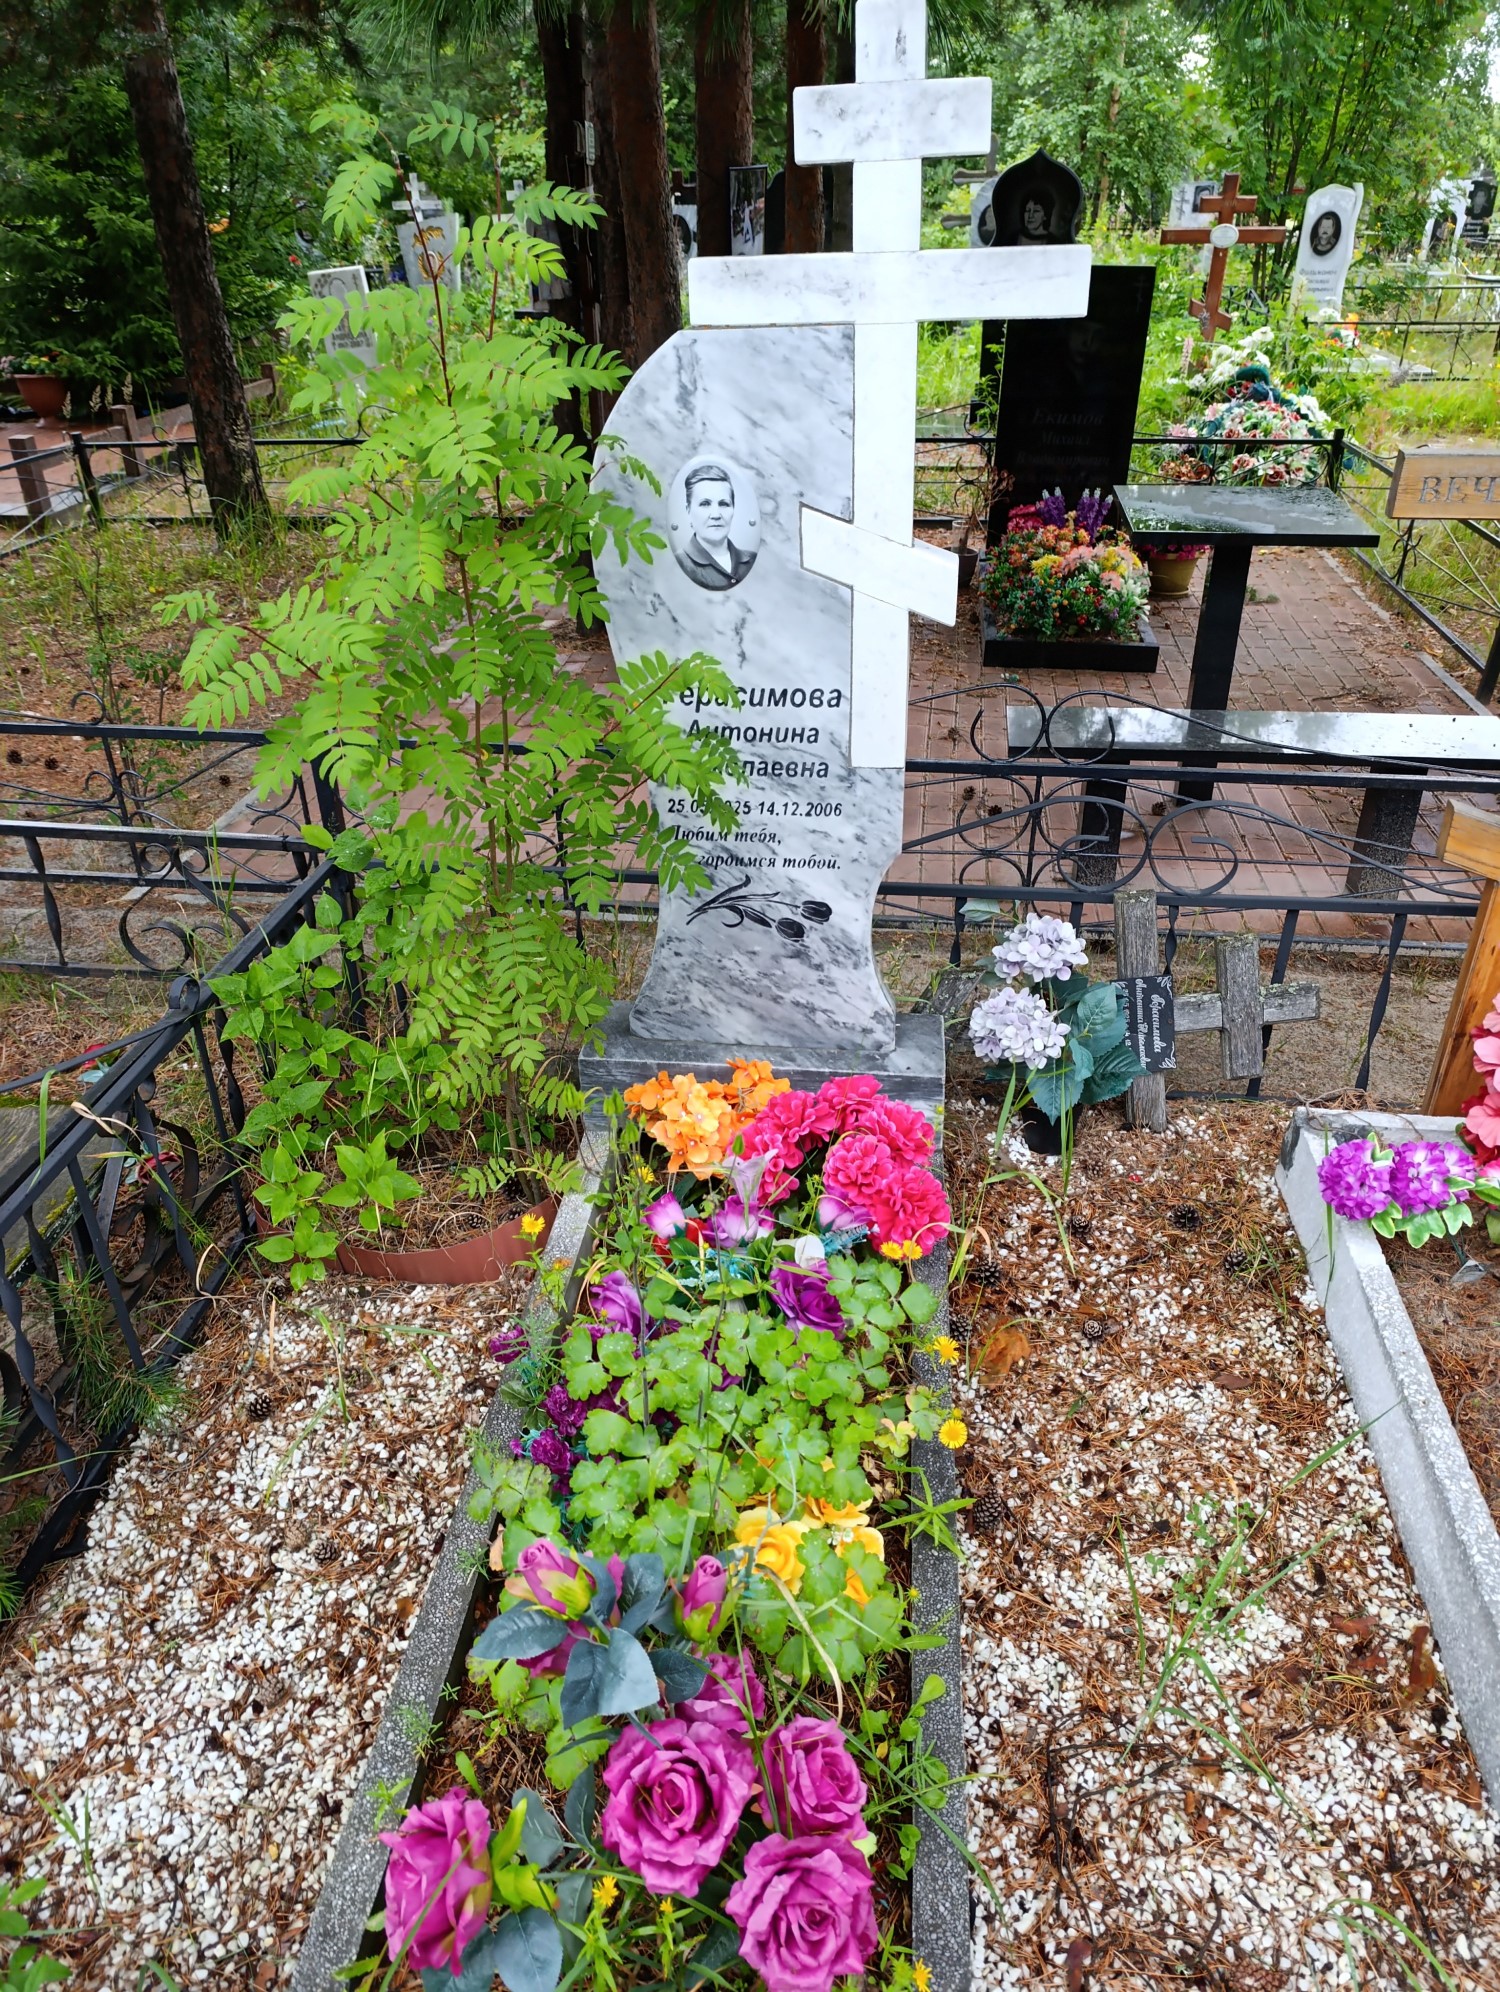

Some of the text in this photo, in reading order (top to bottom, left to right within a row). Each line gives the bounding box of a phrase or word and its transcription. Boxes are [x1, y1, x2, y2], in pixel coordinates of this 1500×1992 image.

[662, 686, 842, 713] ерасимова
[758, 801, 843, 817] 14.12.2006
[734, 828, 781, 846] тебя,
[782, 854, 841, 870] тобой.
[1149, 994, 1166, 1053] Герасимова
